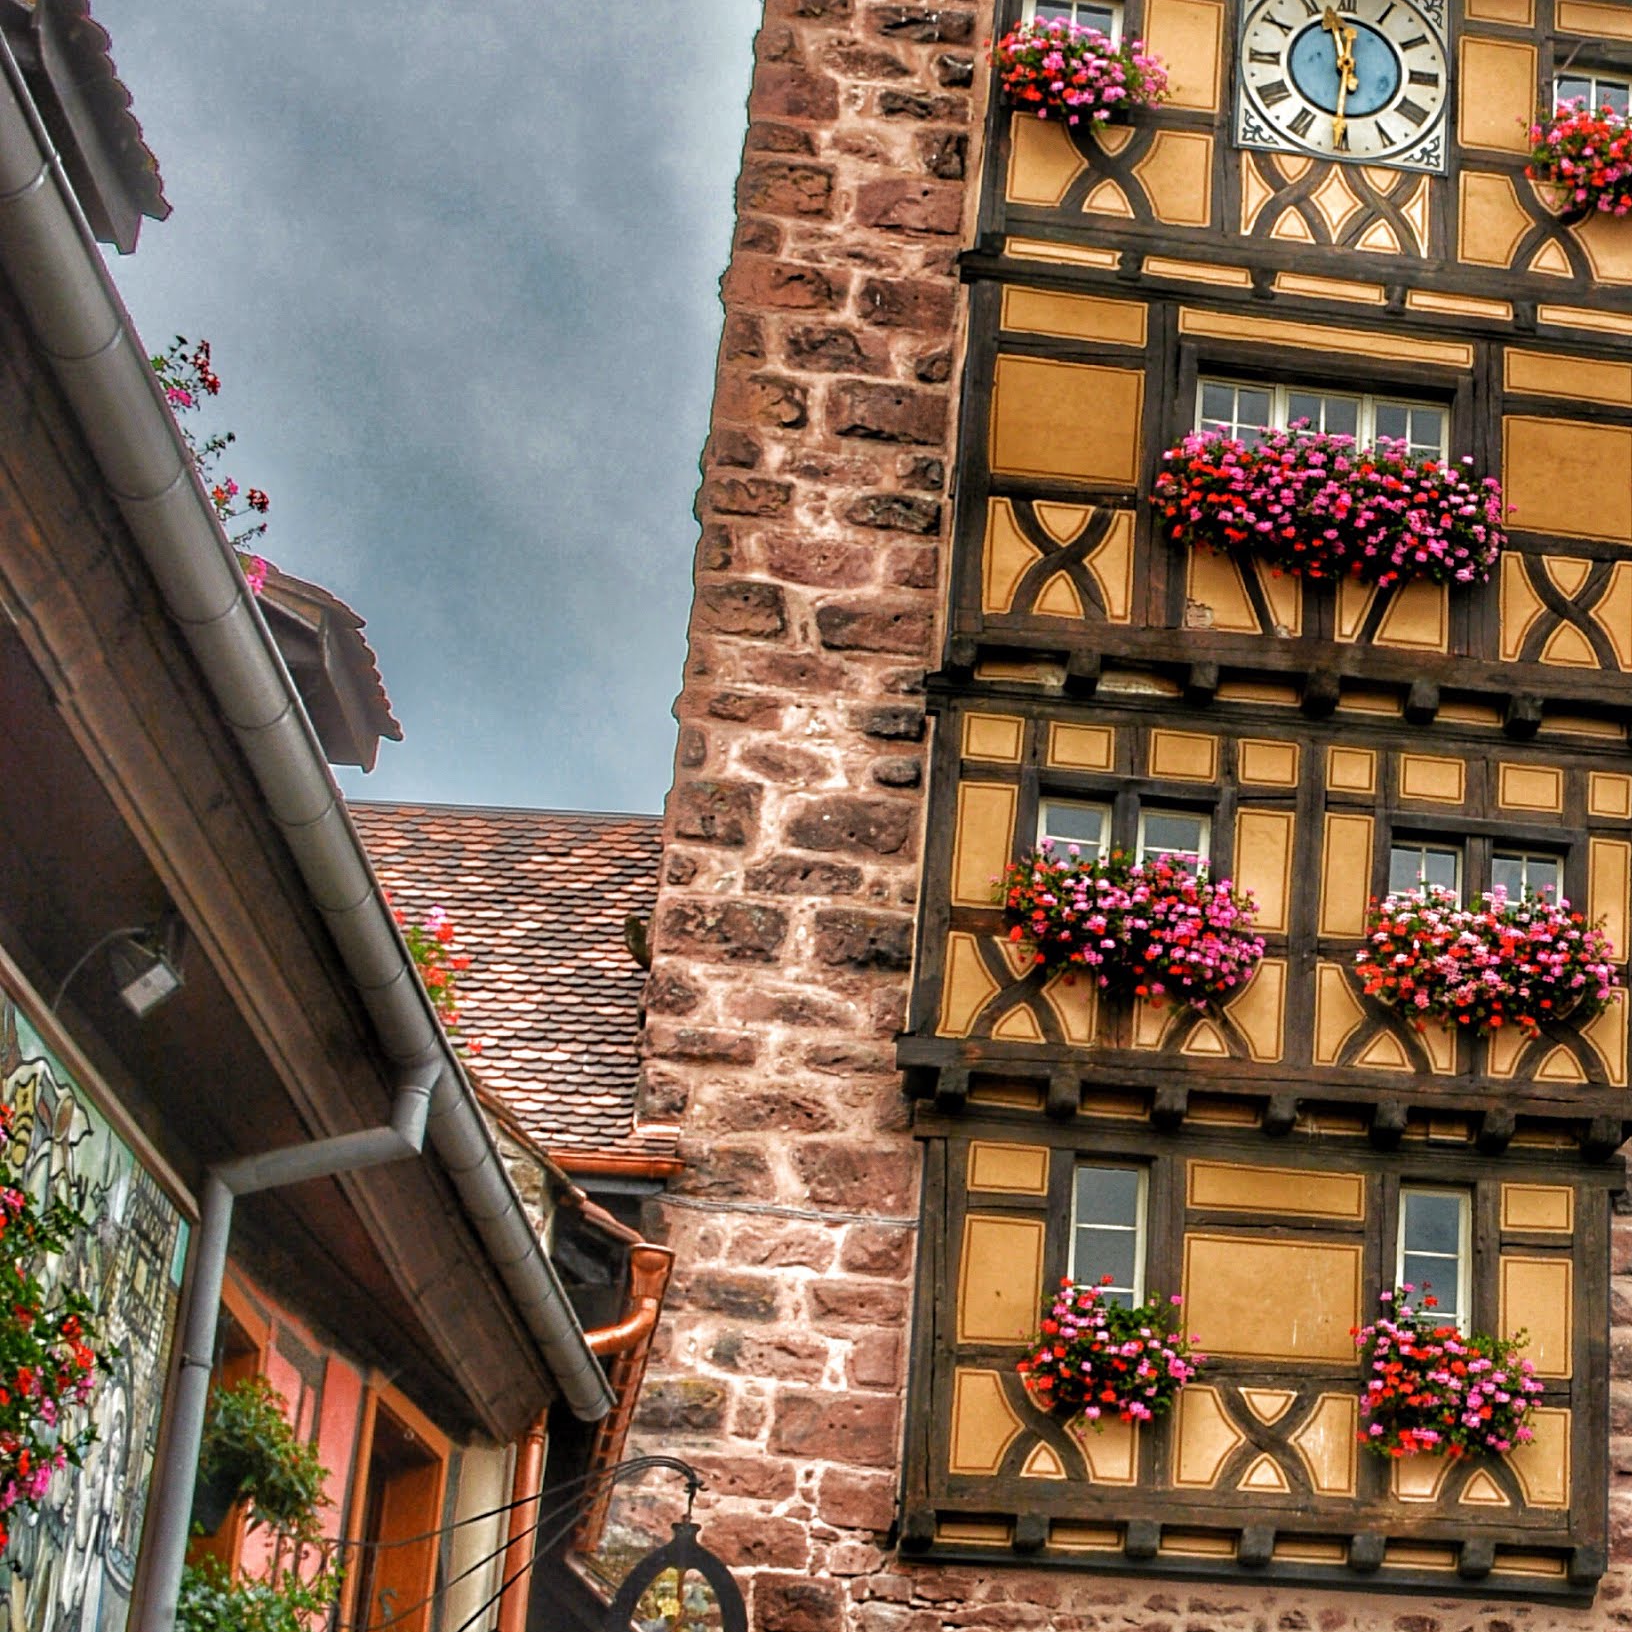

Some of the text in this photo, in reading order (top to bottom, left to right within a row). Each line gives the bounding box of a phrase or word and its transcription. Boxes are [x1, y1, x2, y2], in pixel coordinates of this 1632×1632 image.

[1261, 10, 1294, 37] X
[1375, 1, 1398, 26] I
[1399, 33, 1430, 52] II
[1249, 47, 1280, 66] IX
[1374, 120, 1398, 149] V
